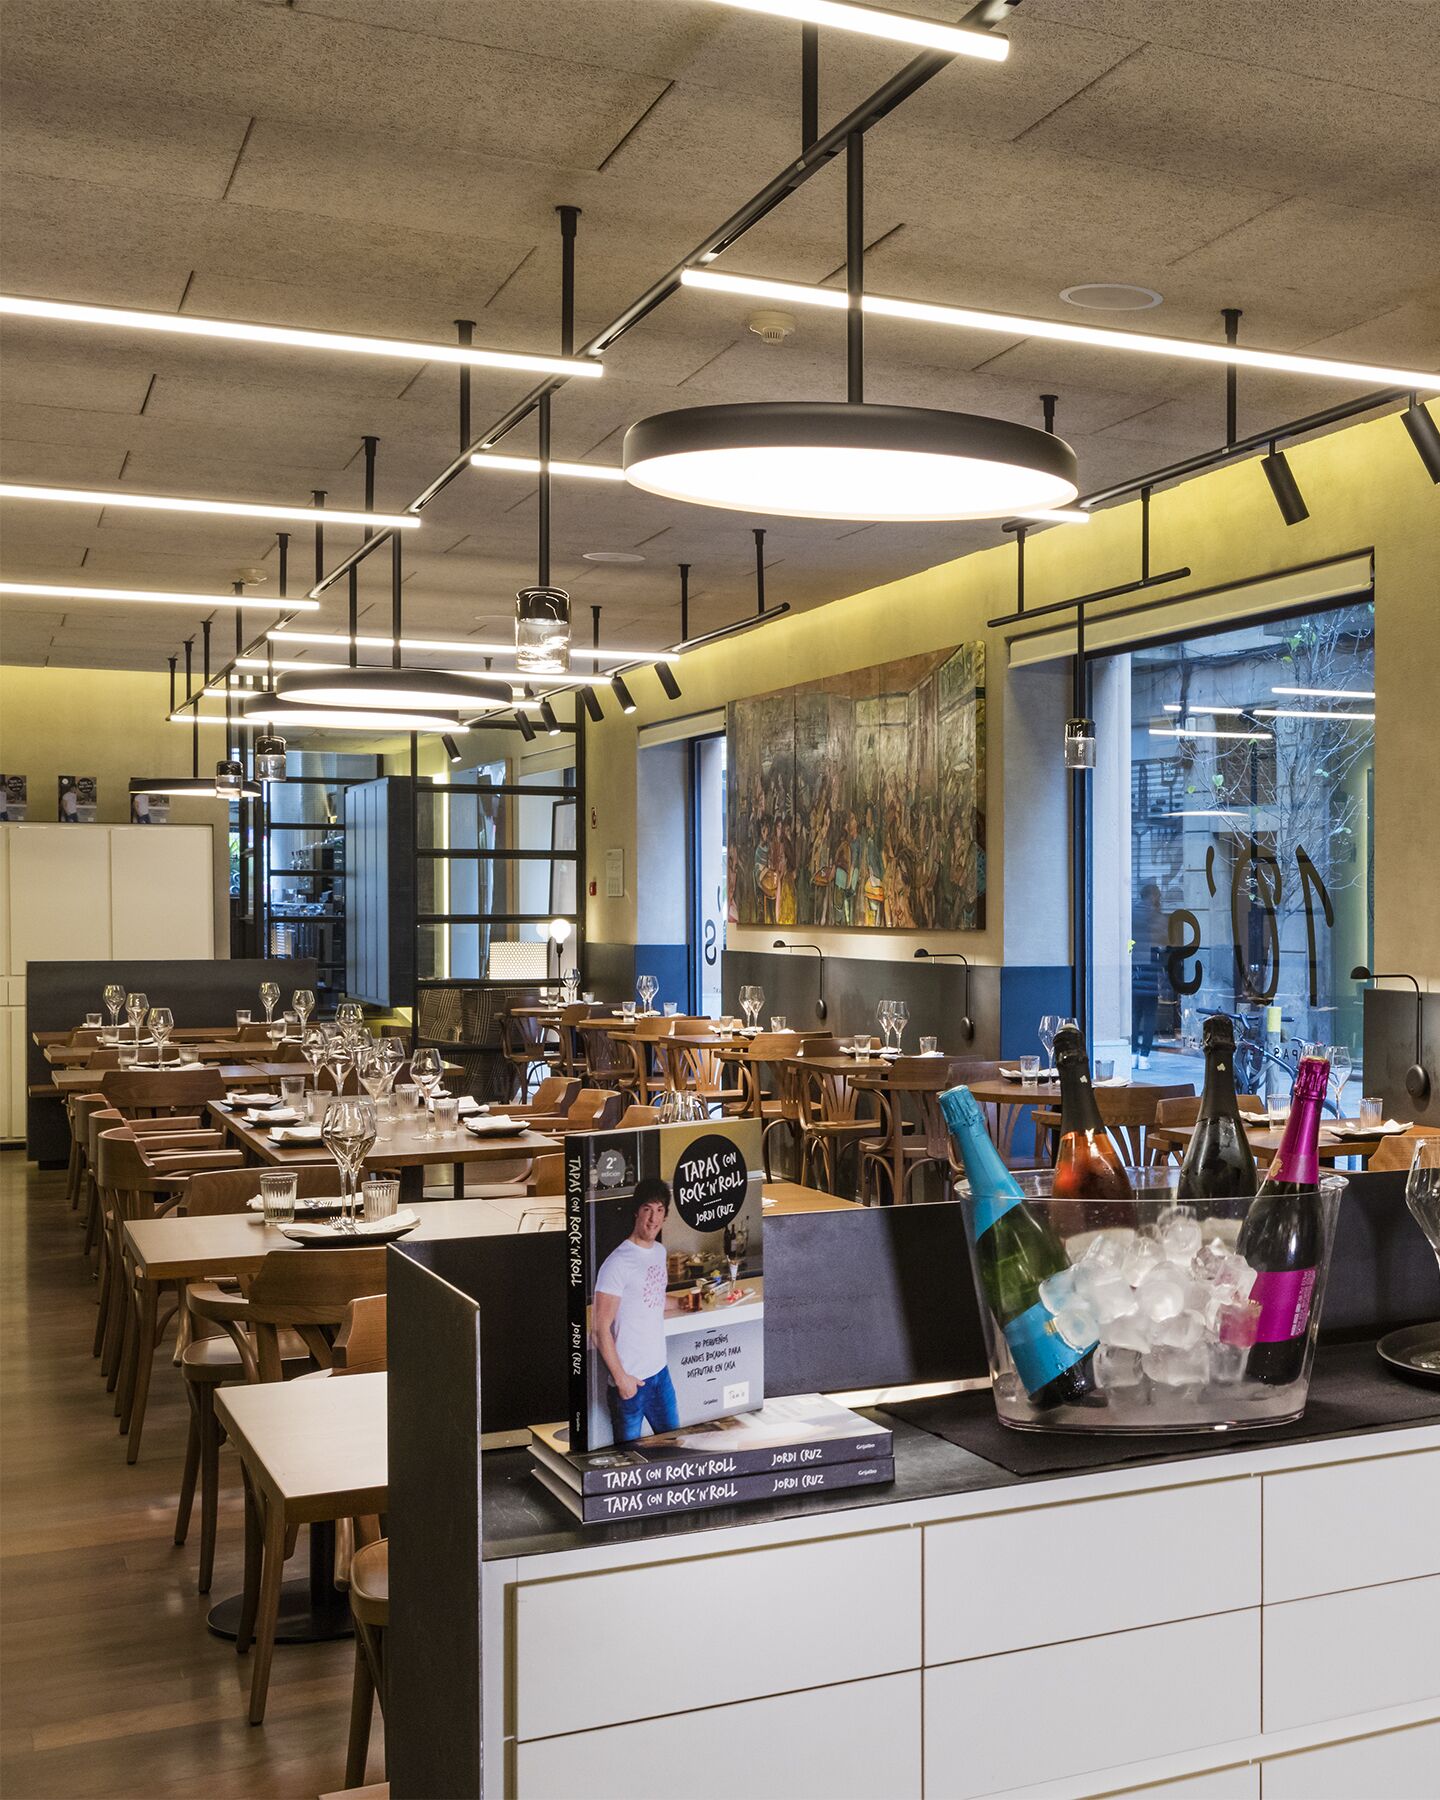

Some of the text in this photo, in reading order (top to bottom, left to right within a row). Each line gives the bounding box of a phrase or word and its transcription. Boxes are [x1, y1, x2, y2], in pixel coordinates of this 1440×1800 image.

[568, 1155, 582, 1193] TAPAS
[679, 1152, 737, 1183] TAPAS CON
[571, 1196, 581, 1213] CON
[695, 1203, 735, 1226] JORDI CRUZ
[571, 1321, 582, 1349] JORDI
[571, 1352, 582, 1375] CRUZ
[680, 1345, 742, 1366] GRANDES BOCADOS PARA
[687, 1360, 737, 1378] DISFRUTAR EN CASA
[602, 1468, 642, 1489] TAPAS
[645, 1468, 662, 1482] CON
[771, 1452, 797, 1466] JORDI
[800, 1448, 822, 1462] CRUZ
[603, 1493, 643, 1514] TAPAS
[646, 1494, 663, 1507] CON
[773, 1477, 798, 1492] JORDI
[801, 1474, 824, 1488] CRUZ
